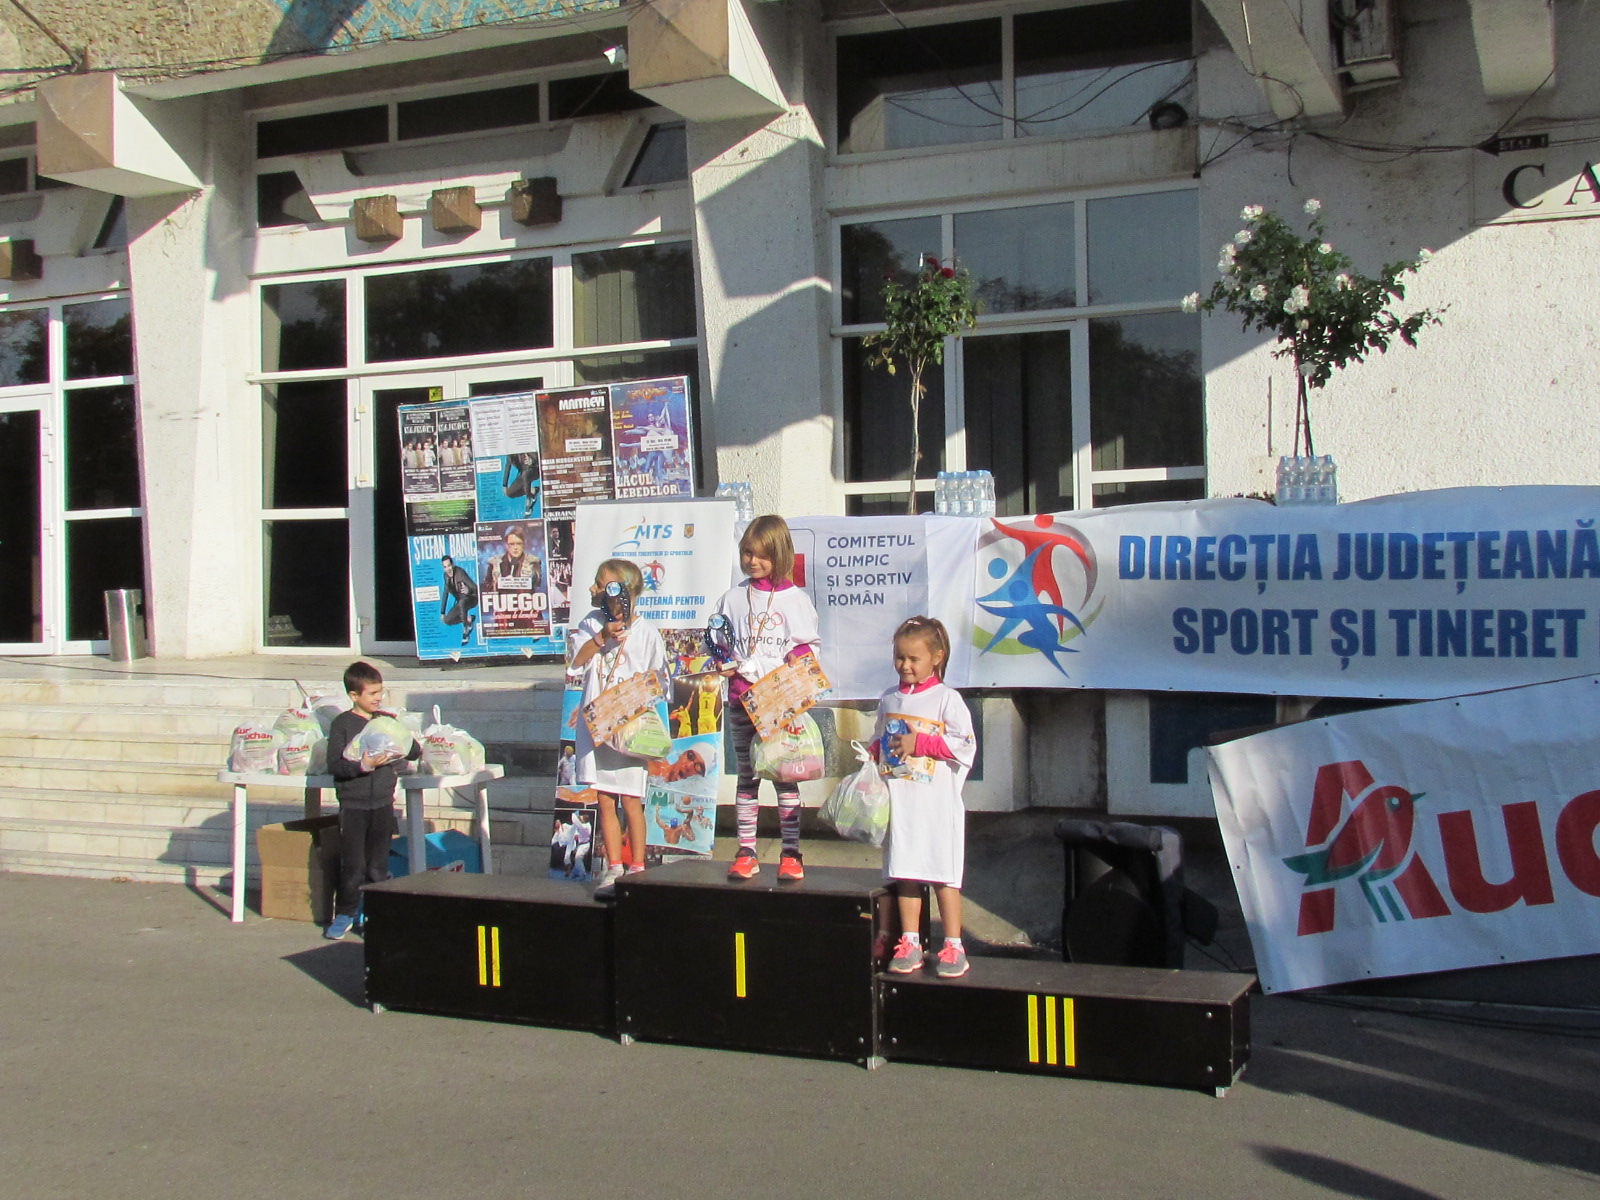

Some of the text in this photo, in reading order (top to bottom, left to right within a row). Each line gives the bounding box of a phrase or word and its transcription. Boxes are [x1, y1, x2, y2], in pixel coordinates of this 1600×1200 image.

[616, 473, 653, 487] LACUL
[616, 484, 678, 499] LEBEDELOR
[634, 524, 673, 540] MTS
[827, 534, 915, 549] COMITETUL
[827, 554, 890, 568] OLIMPIC
[1118, 518, 1600, 596] DIRECȚIA JUDEȚEANĂ
[827, 572, 913, 591] ȘI SPORTIV
[482, 592, 548, 613] FUEGO
[675, 596, 705, 605] PENTRU
[828, 590, 885, 606] ROMÂN
[639, 610, 670, 620] TINERET
[671, 610, 697, 620] BIHOR
[1172, 607, 1586, 671] SPORT ȘI TINERET
